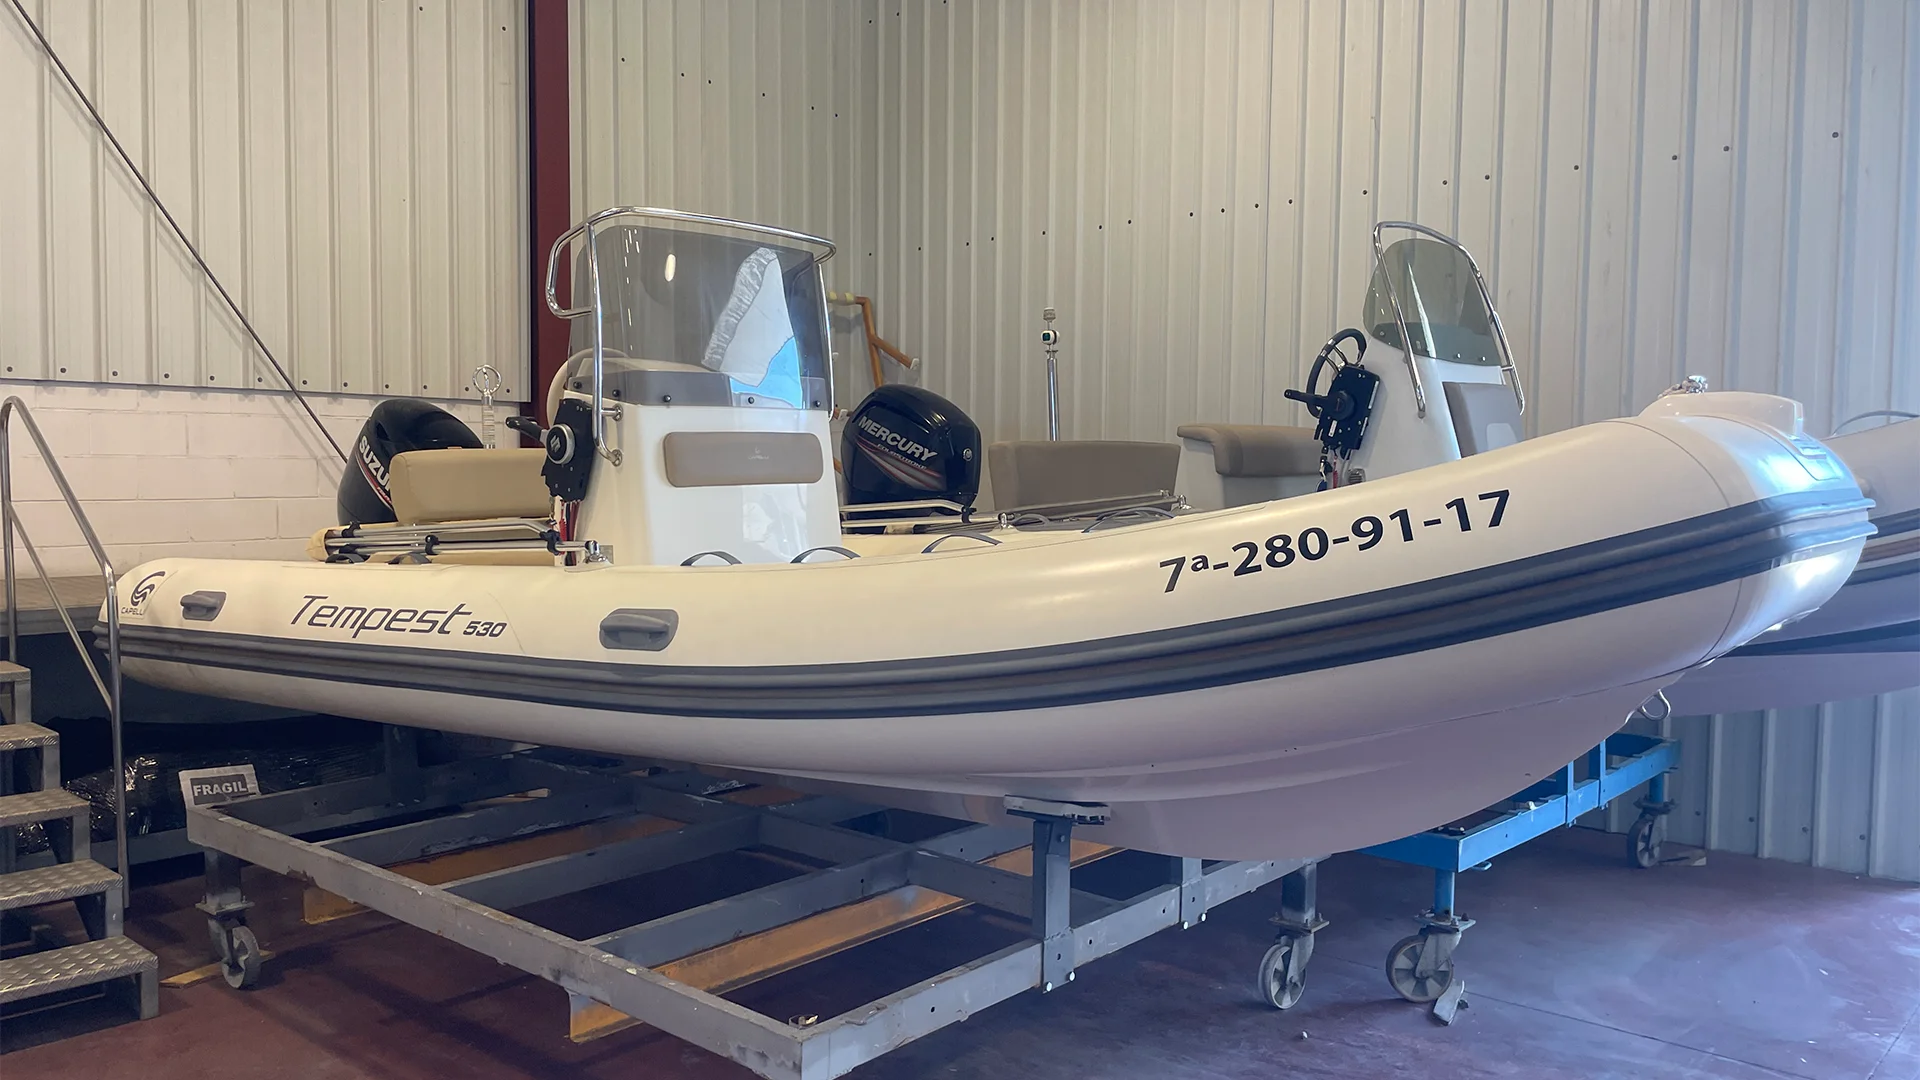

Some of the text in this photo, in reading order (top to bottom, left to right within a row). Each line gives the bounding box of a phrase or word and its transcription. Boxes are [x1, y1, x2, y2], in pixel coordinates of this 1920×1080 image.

[859, 416, 938, 461] MERCURY
[291, 595, 507, 638] Tempest 530
[193, 781, 247, 797] FRAGIL
